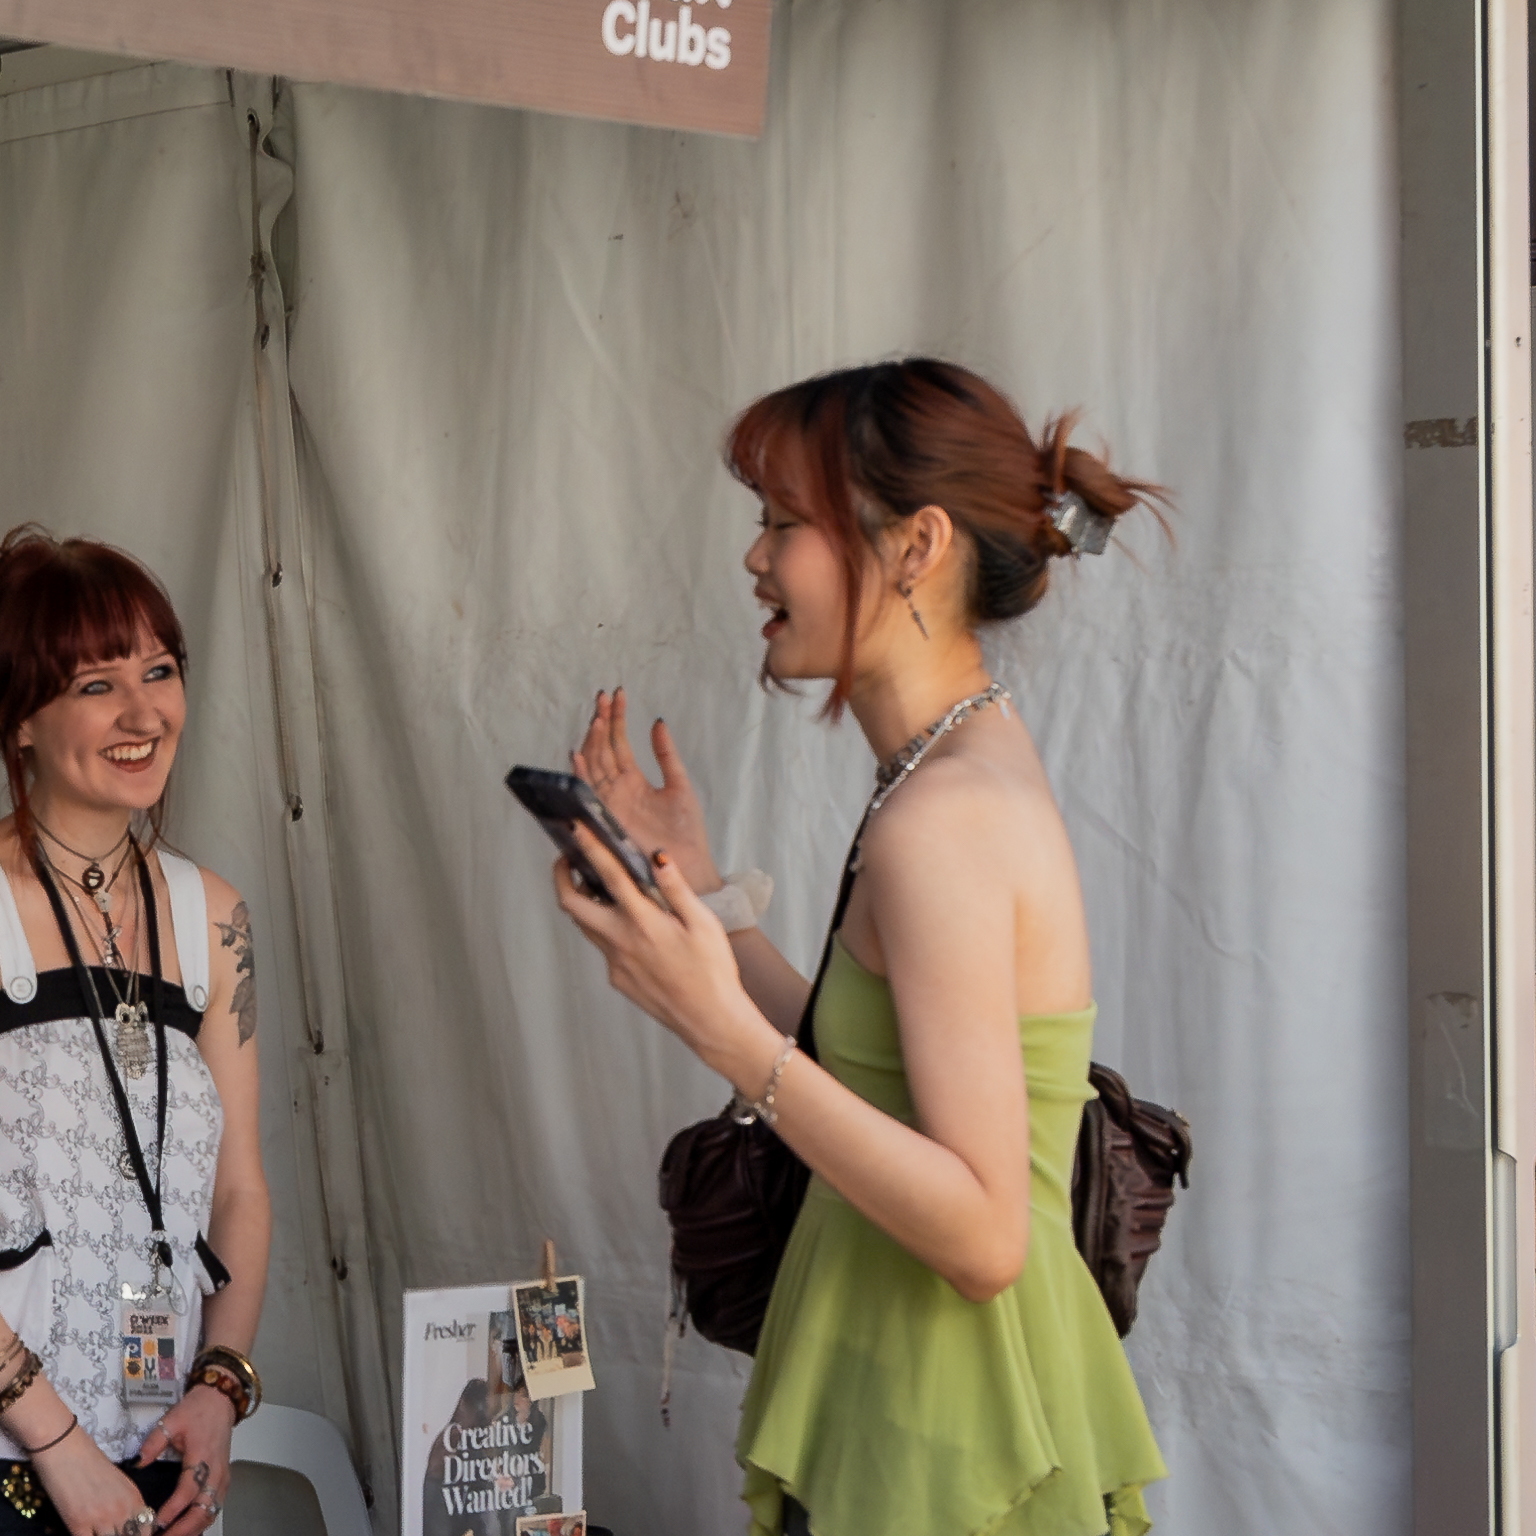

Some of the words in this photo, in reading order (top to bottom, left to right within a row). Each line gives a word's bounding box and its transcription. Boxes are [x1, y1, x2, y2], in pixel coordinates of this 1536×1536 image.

[443, 1415, 533, 1453] Creative
[443, 1450, 545, 1485] Directors
[442, 1476, 533, 1516] Wanted!
